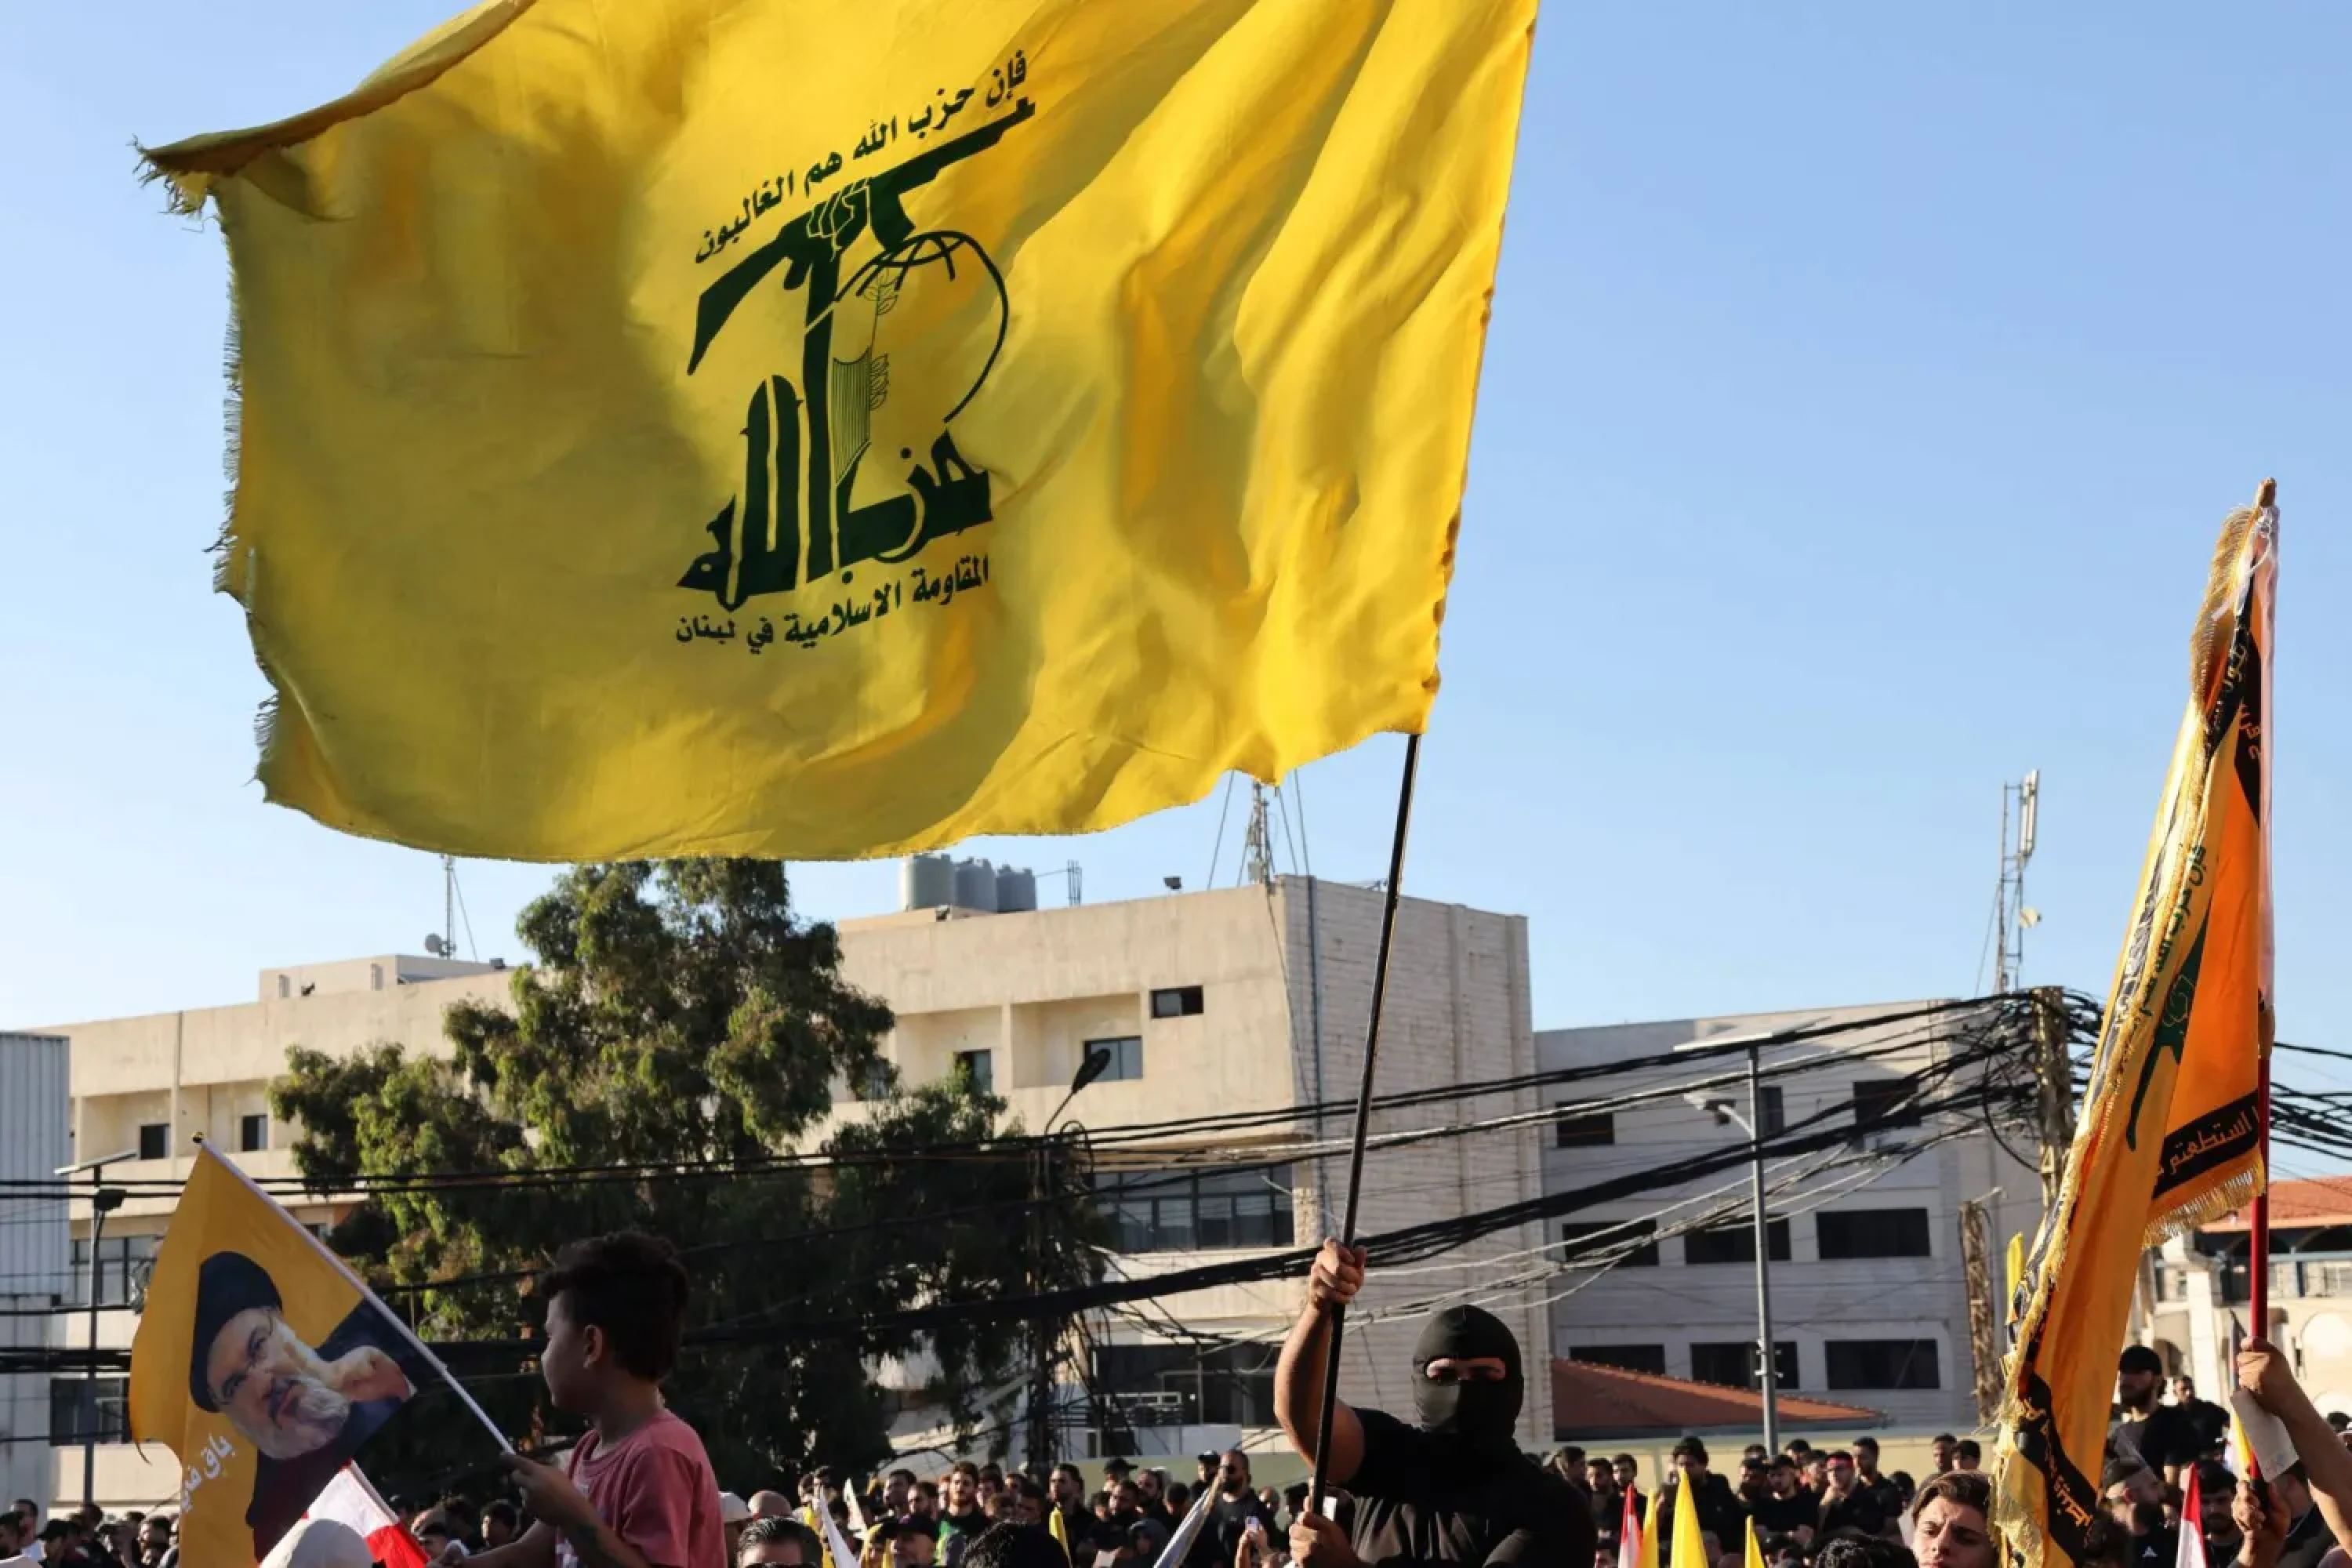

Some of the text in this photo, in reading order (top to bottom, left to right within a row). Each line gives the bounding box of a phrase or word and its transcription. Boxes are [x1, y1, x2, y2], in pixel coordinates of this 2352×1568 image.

[695, 49, 1027, 264] فإن حزب الله هم الغالبون
[675, 554, 989, 655] المقاومة الاسلامية في لبنان
